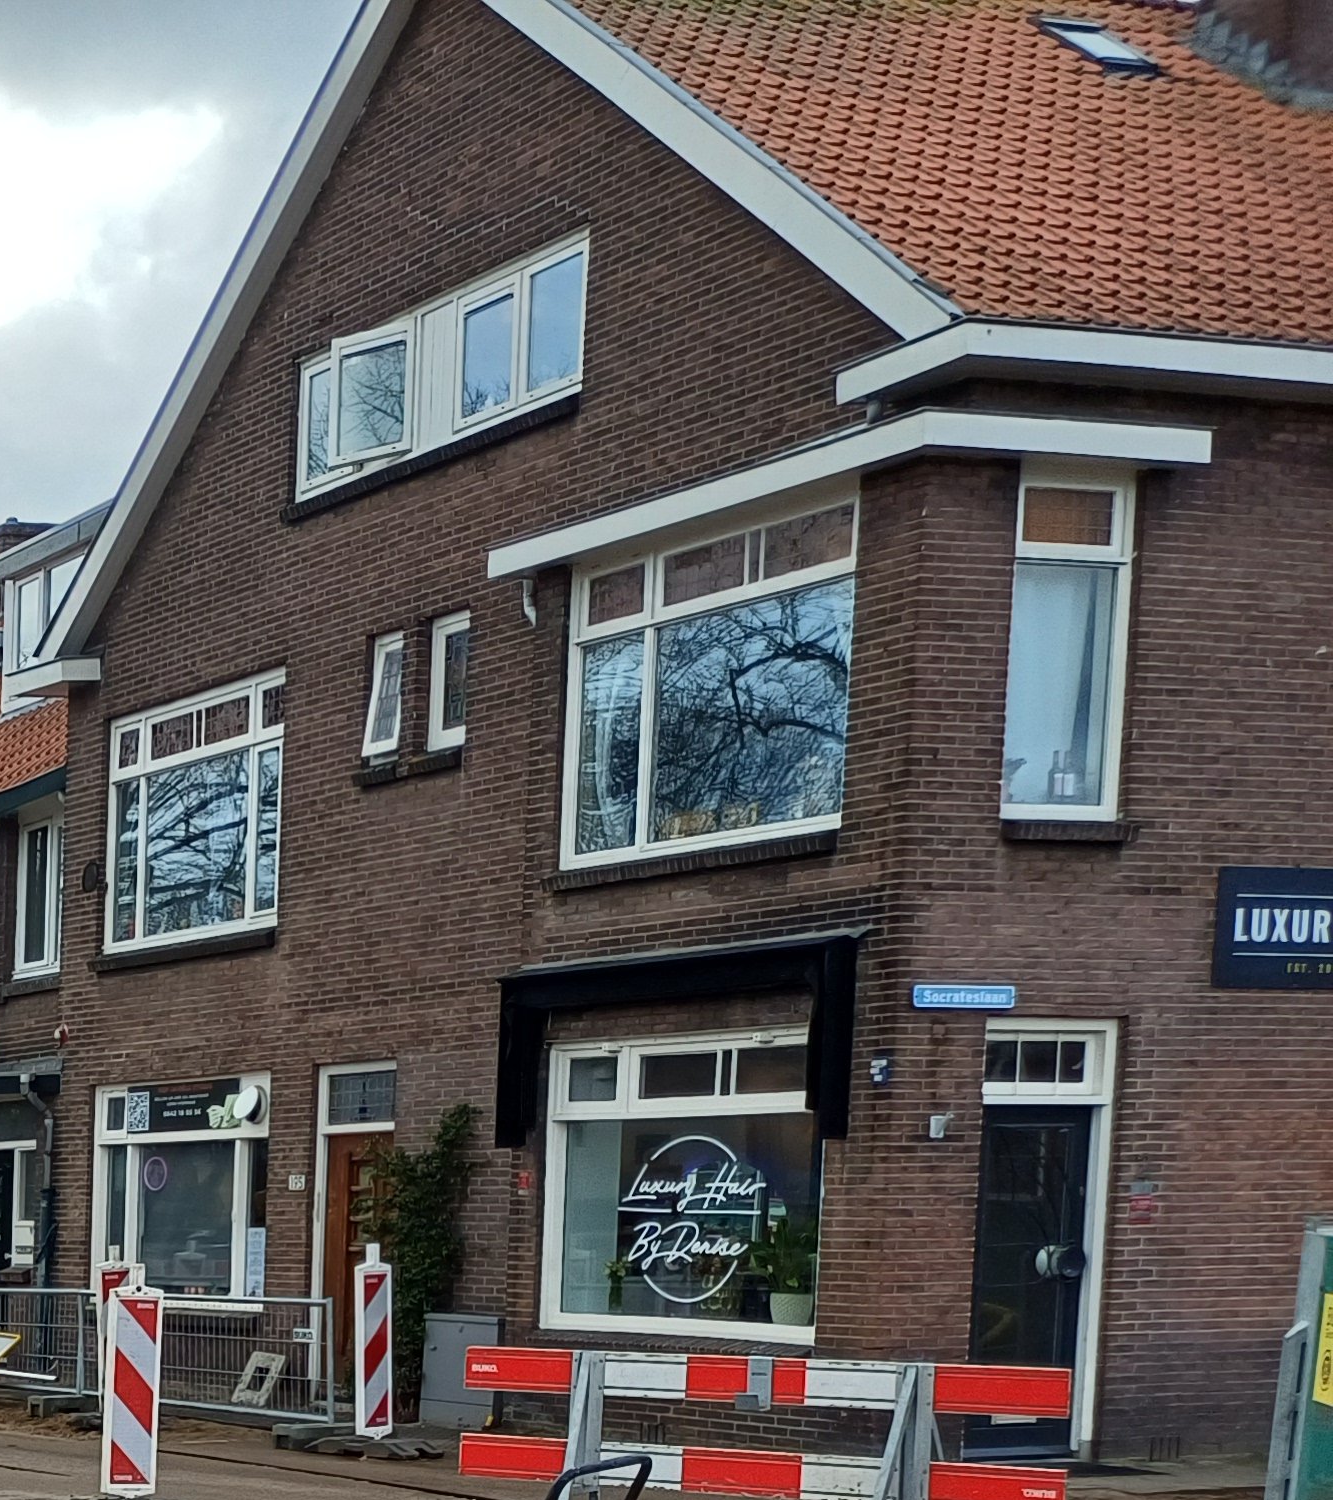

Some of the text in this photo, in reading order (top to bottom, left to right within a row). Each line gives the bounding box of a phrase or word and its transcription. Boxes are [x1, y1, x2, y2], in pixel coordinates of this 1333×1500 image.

[1234, 908, 1331, 943] LUXUR
[923, 990, 1007, 1003] Socrateslaan
[622, 1162, 767, 1211] Luxury Hair
[628, 1221, 749, 1270] By Denise
